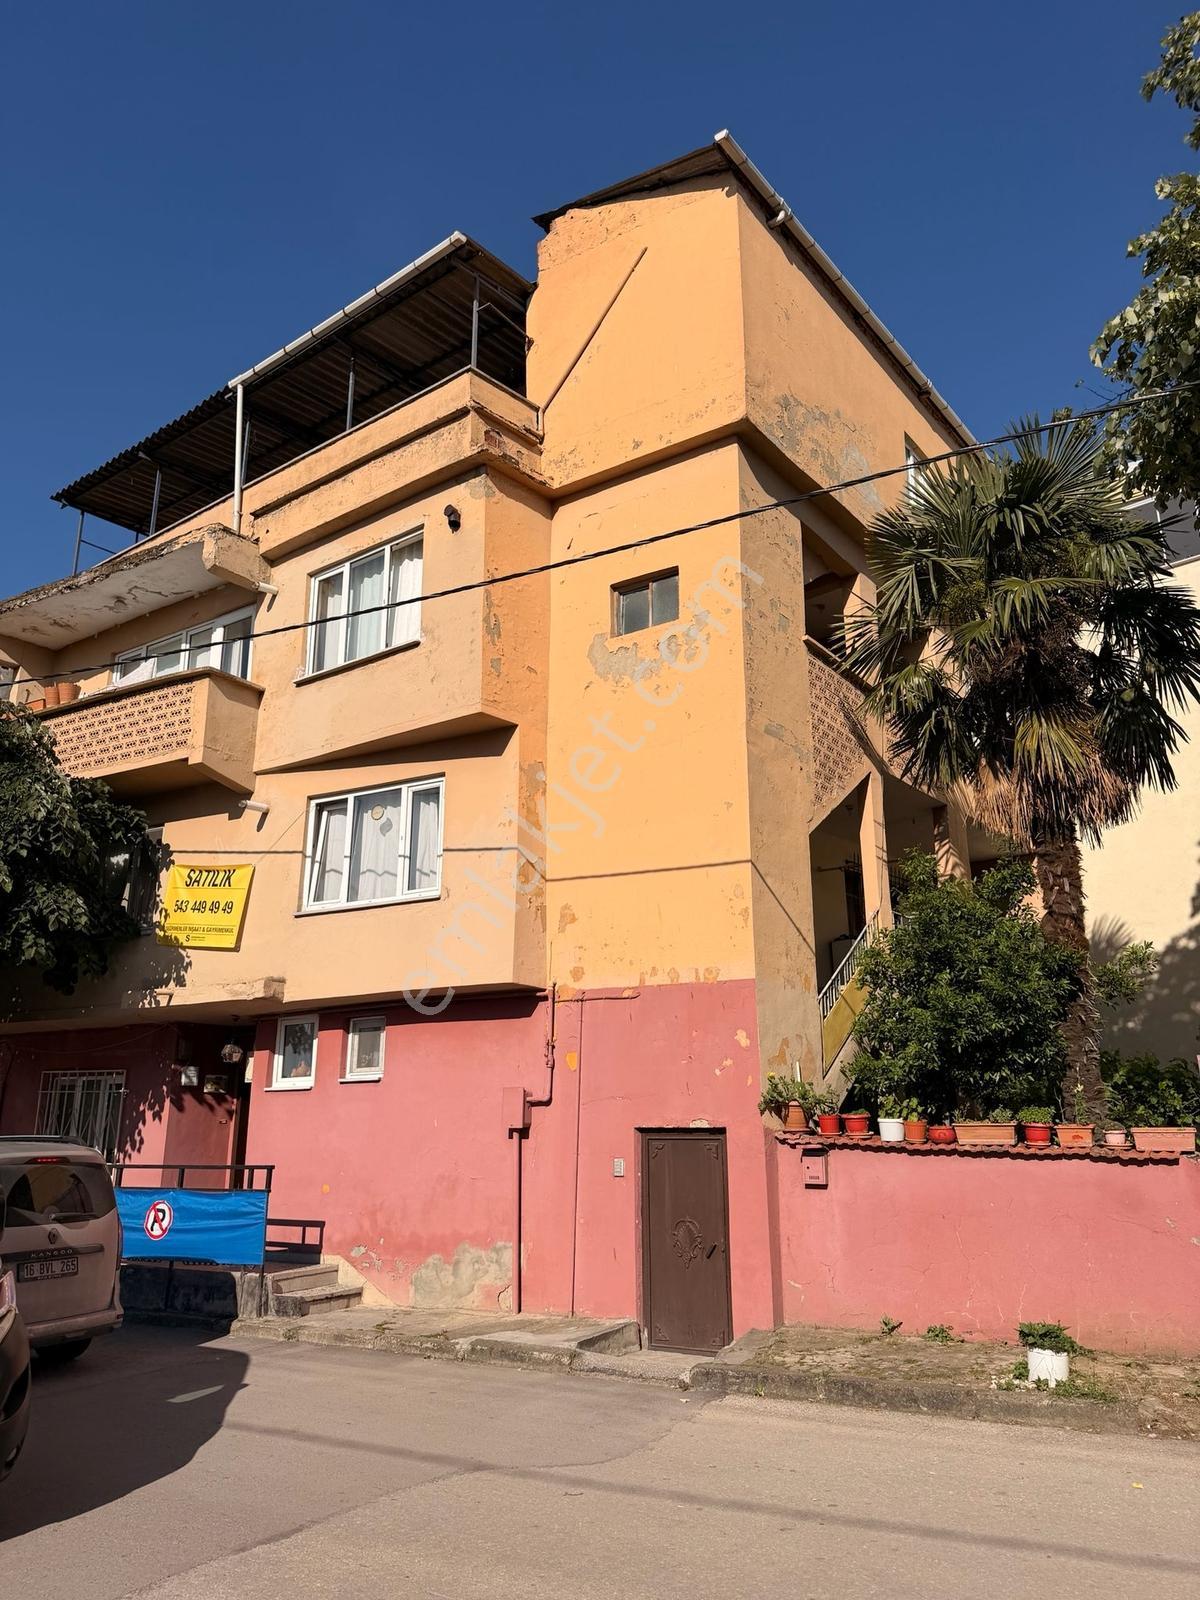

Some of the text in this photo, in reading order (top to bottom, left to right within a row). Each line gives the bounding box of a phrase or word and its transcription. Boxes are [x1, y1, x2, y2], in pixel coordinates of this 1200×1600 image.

[185, 868, 236, 887] SATILIK
[174, 900, 234, 914] 543 449 49 49
[31, 1249, 73, 1258] KANGOO
[24, 1259, 76, 1277] 16 BVL 265
